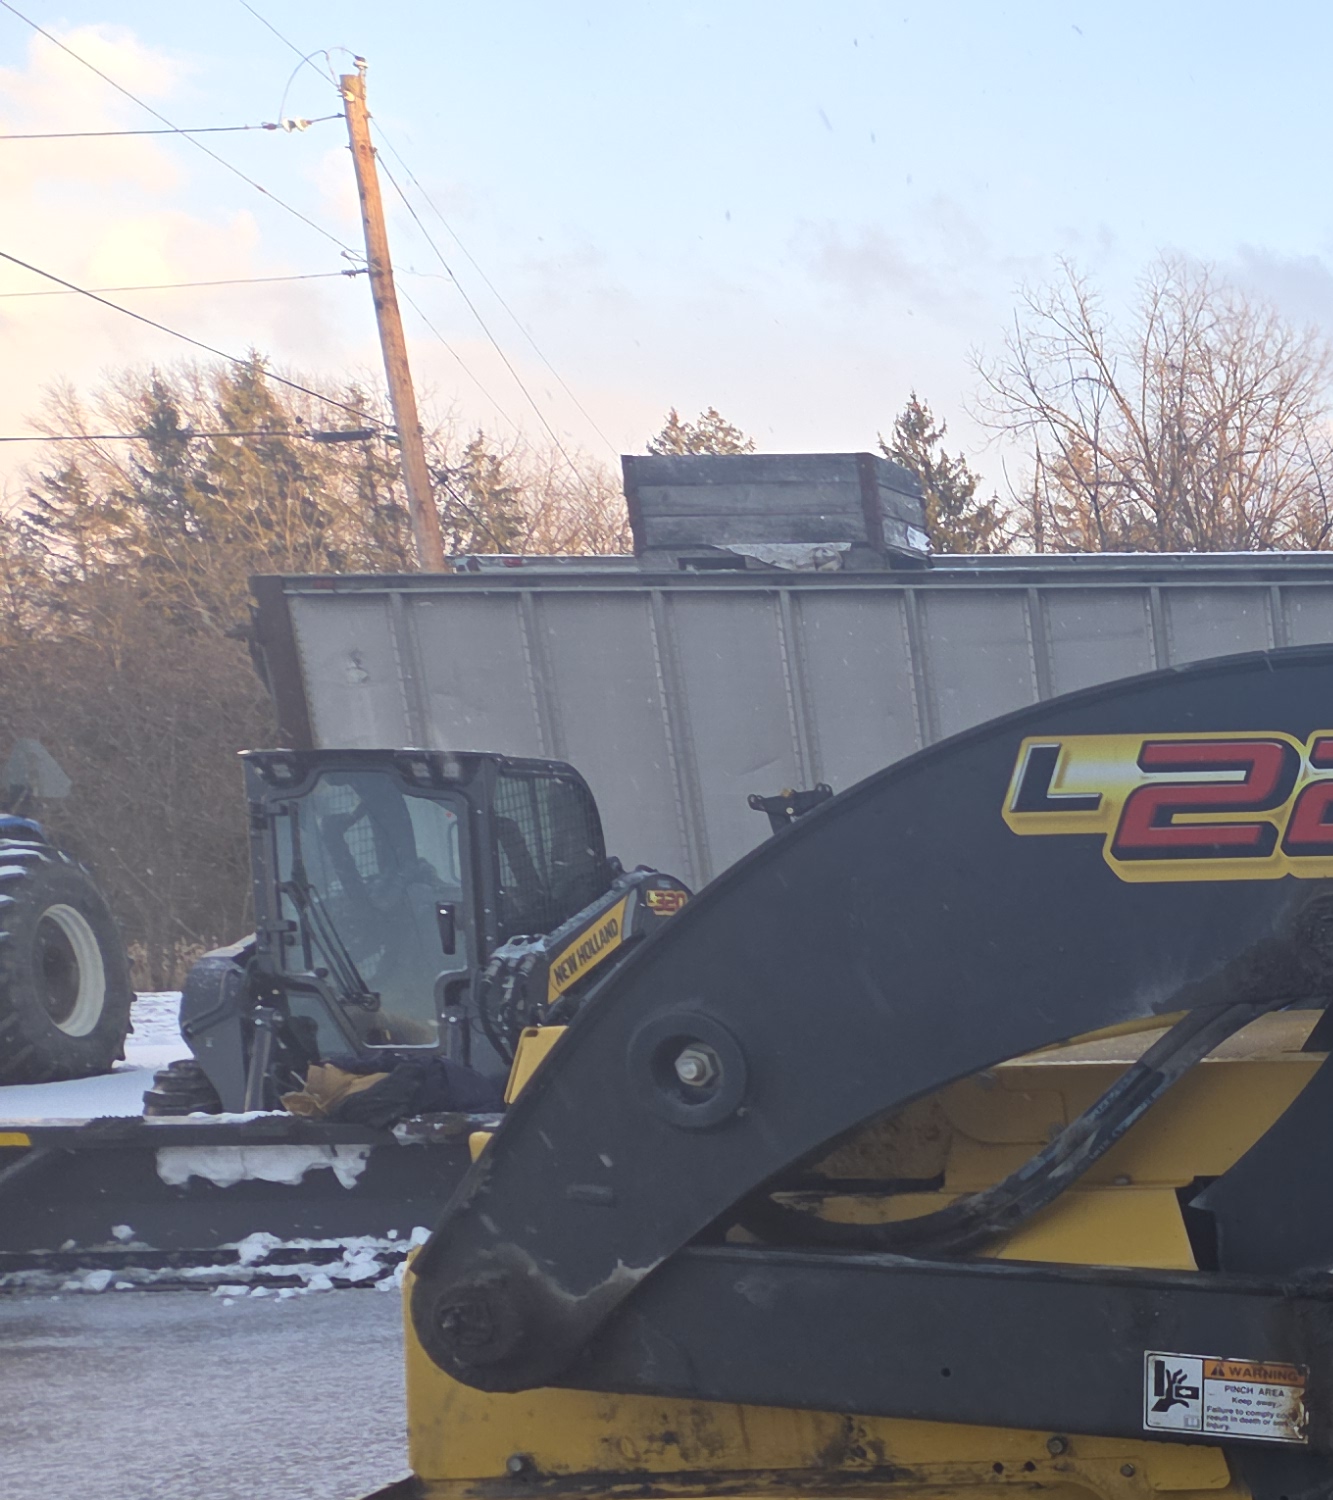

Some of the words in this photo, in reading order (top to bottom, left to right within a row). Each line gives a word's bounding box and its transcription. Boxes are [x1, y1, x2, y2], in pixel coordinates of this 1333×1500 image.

[553, 955, 579, 987] NEW
[576, 918, 619, 967] HOLLAND
[1229, 1367, 1298, 1381] WARNING
[1224, 1385, 1254, 1395] PINCH
[1258, 1387, 1285, 1398] AREA
[1231, 1397, 1253, 1406] Keep
[1206, 1405, 1234, 1415] Failure
